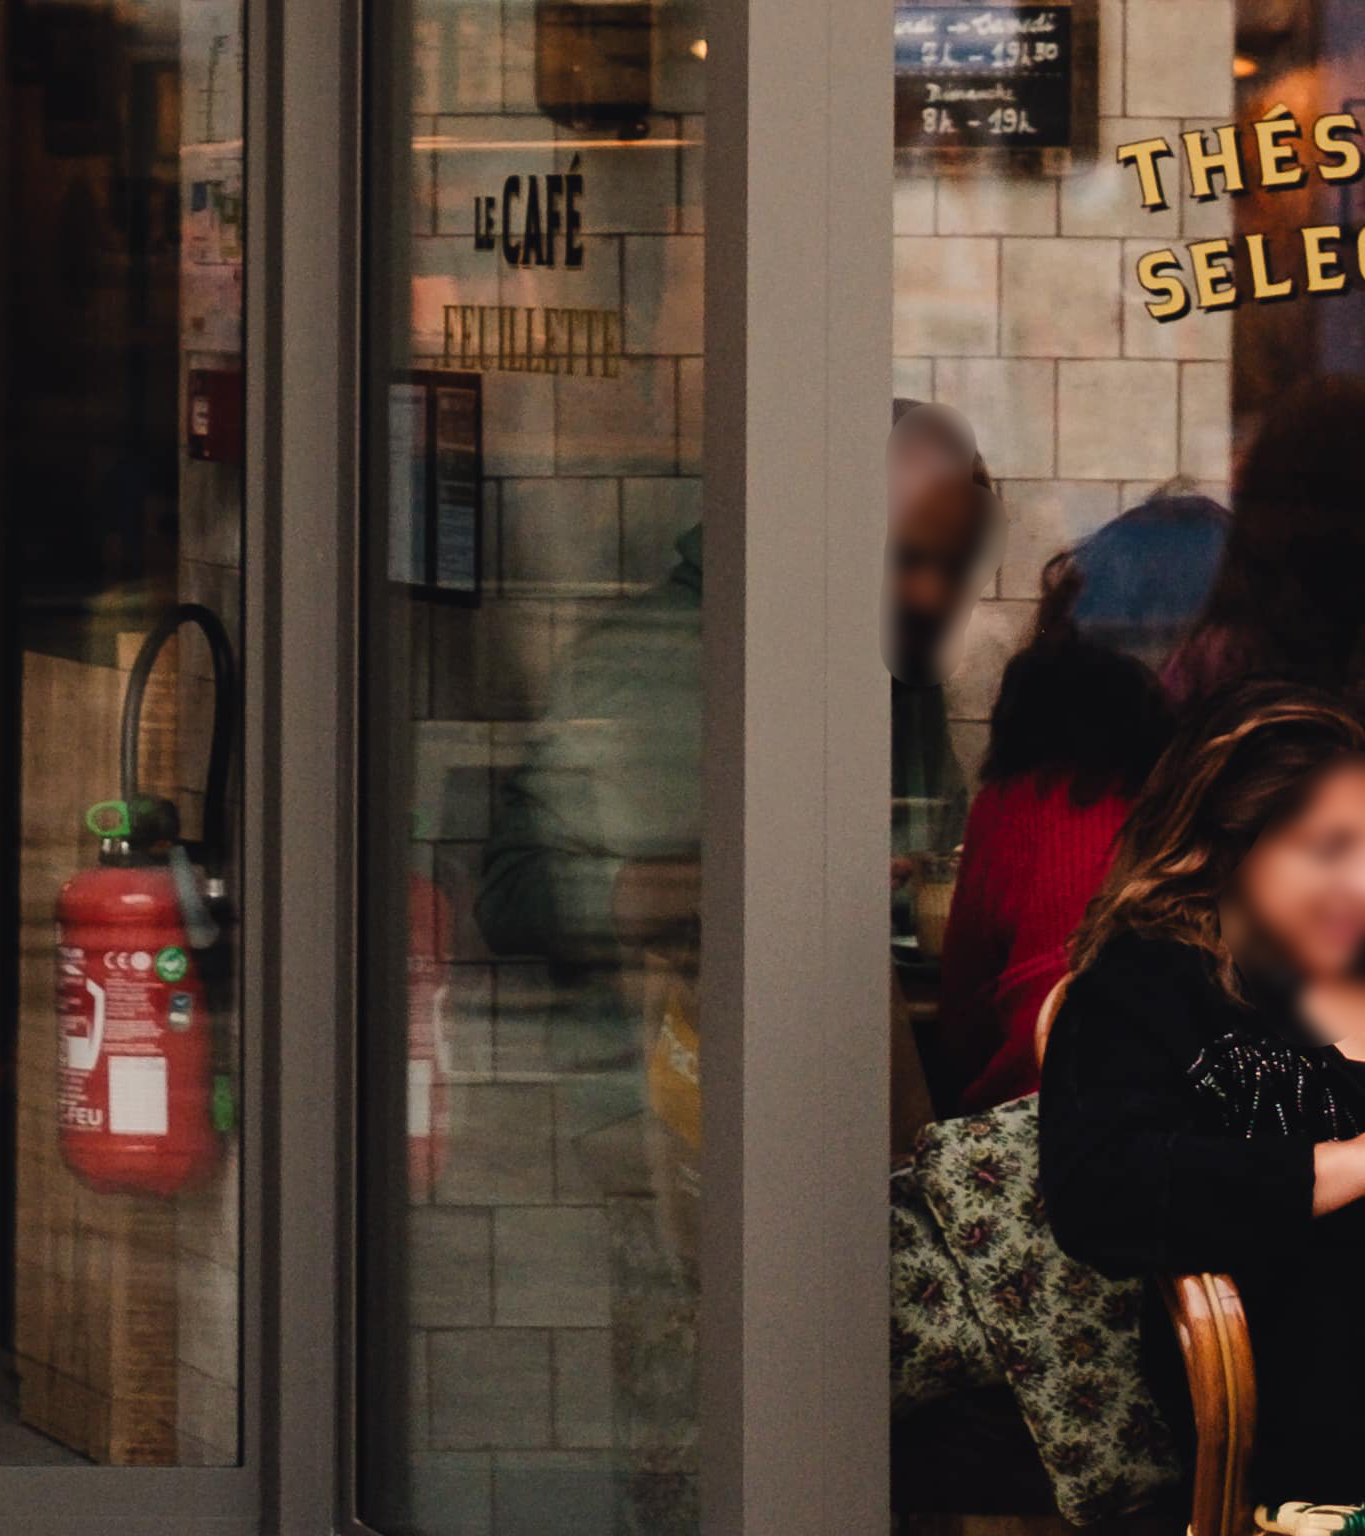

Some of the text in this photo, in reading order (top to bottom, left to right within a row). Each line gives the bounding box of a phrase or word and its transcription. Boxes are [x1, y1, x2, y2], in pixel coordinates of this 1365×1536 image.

[1117, 104, 1362, 210] THÉS
[475, 152, 585, 270] LE CAFÉ
[1137, 226, 1365, 322] SELE
[443, 304, 620, 378] FEUILLETTE
